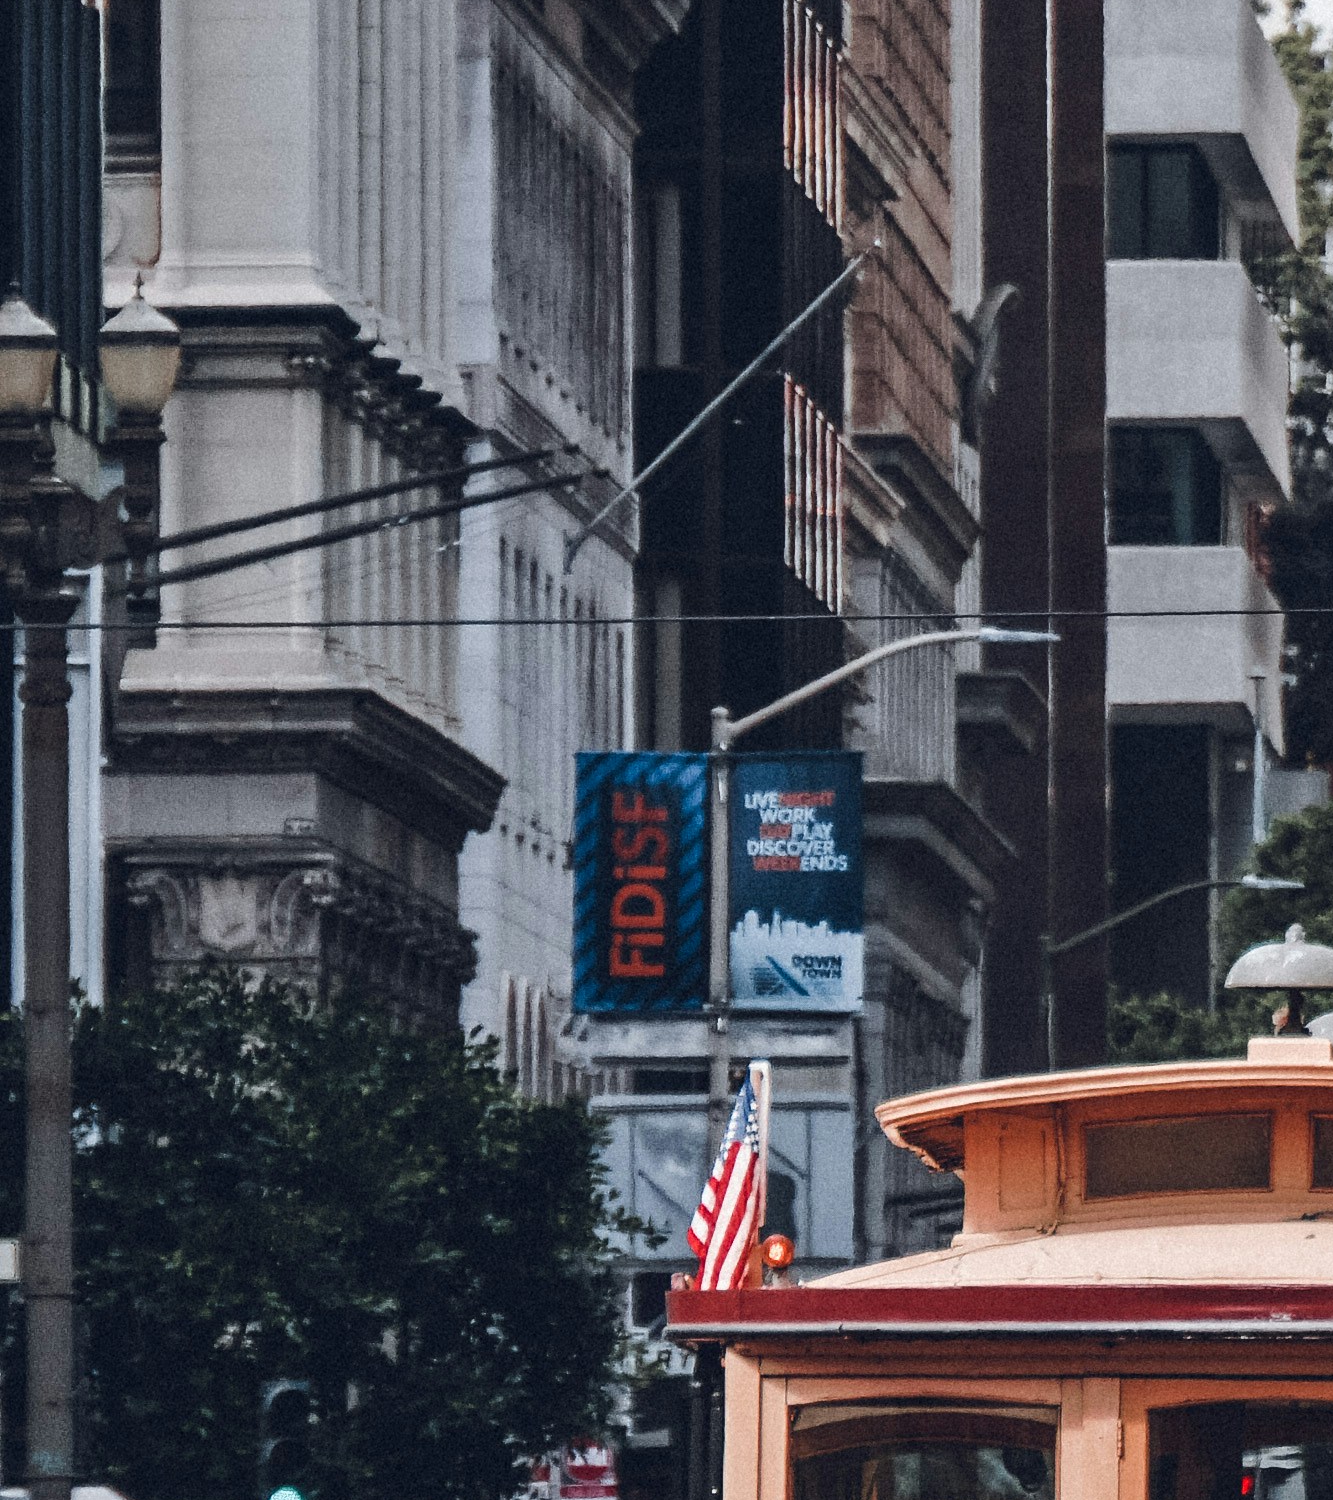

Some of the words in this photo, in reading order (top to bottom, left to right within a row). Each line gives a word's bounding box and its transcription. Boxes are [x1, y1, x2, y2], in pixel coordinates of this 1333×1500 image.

[744, 791, 779, 809] LIVE
[759, 807, 817, 824] WORK
[746, 839, 836, 857] DISCOVER
[608, 791, 668, 977] FiDiSF
[791, 955, 843, 969] DOWN
